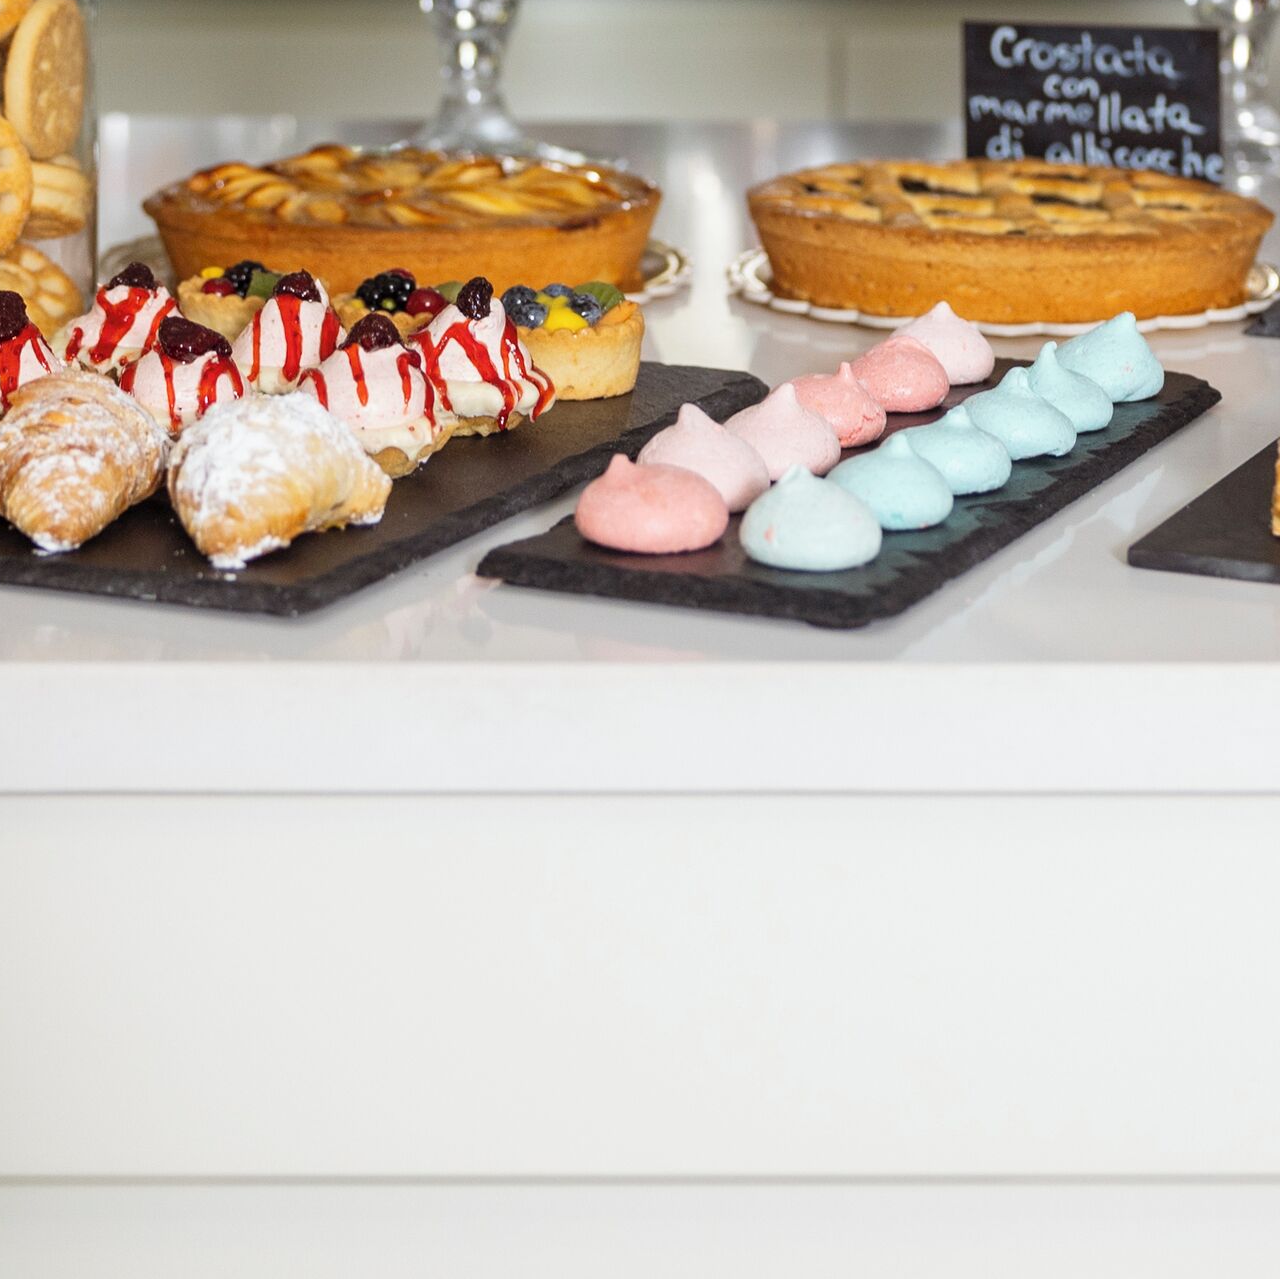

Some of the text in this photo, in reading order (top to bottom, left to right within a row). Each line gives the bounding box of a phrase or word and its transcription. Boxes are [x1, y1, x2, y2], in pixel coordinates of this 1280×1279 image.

[989, 25, 1182, 81] Crostata
[1042, 73, 1101, 101] con
[969, 91, 1206, 135] marmellata
[985, 123, 1025, 161] di
